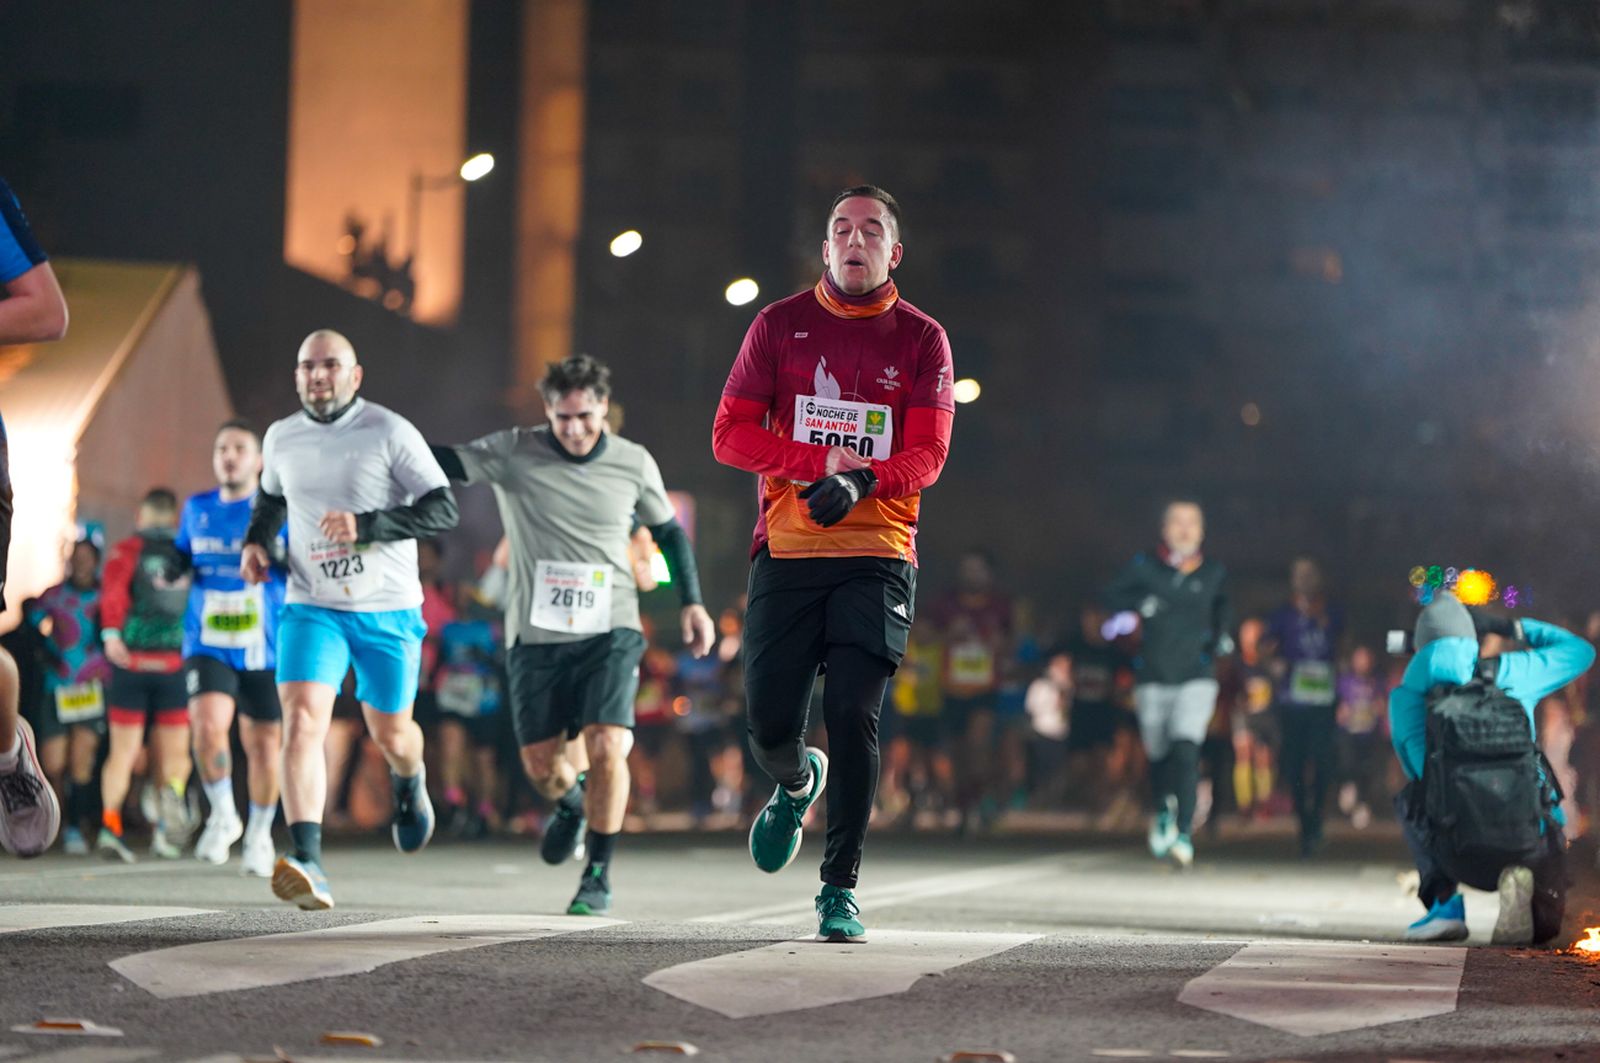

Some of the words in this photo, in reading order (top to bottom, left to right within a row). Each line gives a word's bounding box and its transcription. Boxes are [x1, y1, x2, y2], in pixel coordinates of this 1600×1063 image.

[805, 417, 823, 429] SAN
[816, 408, 846, 420] NOCHE
[847, 412, 858, 421] DE
[320, 554, 364, 578] 1223
[551, 587, 595, 608] 2619
